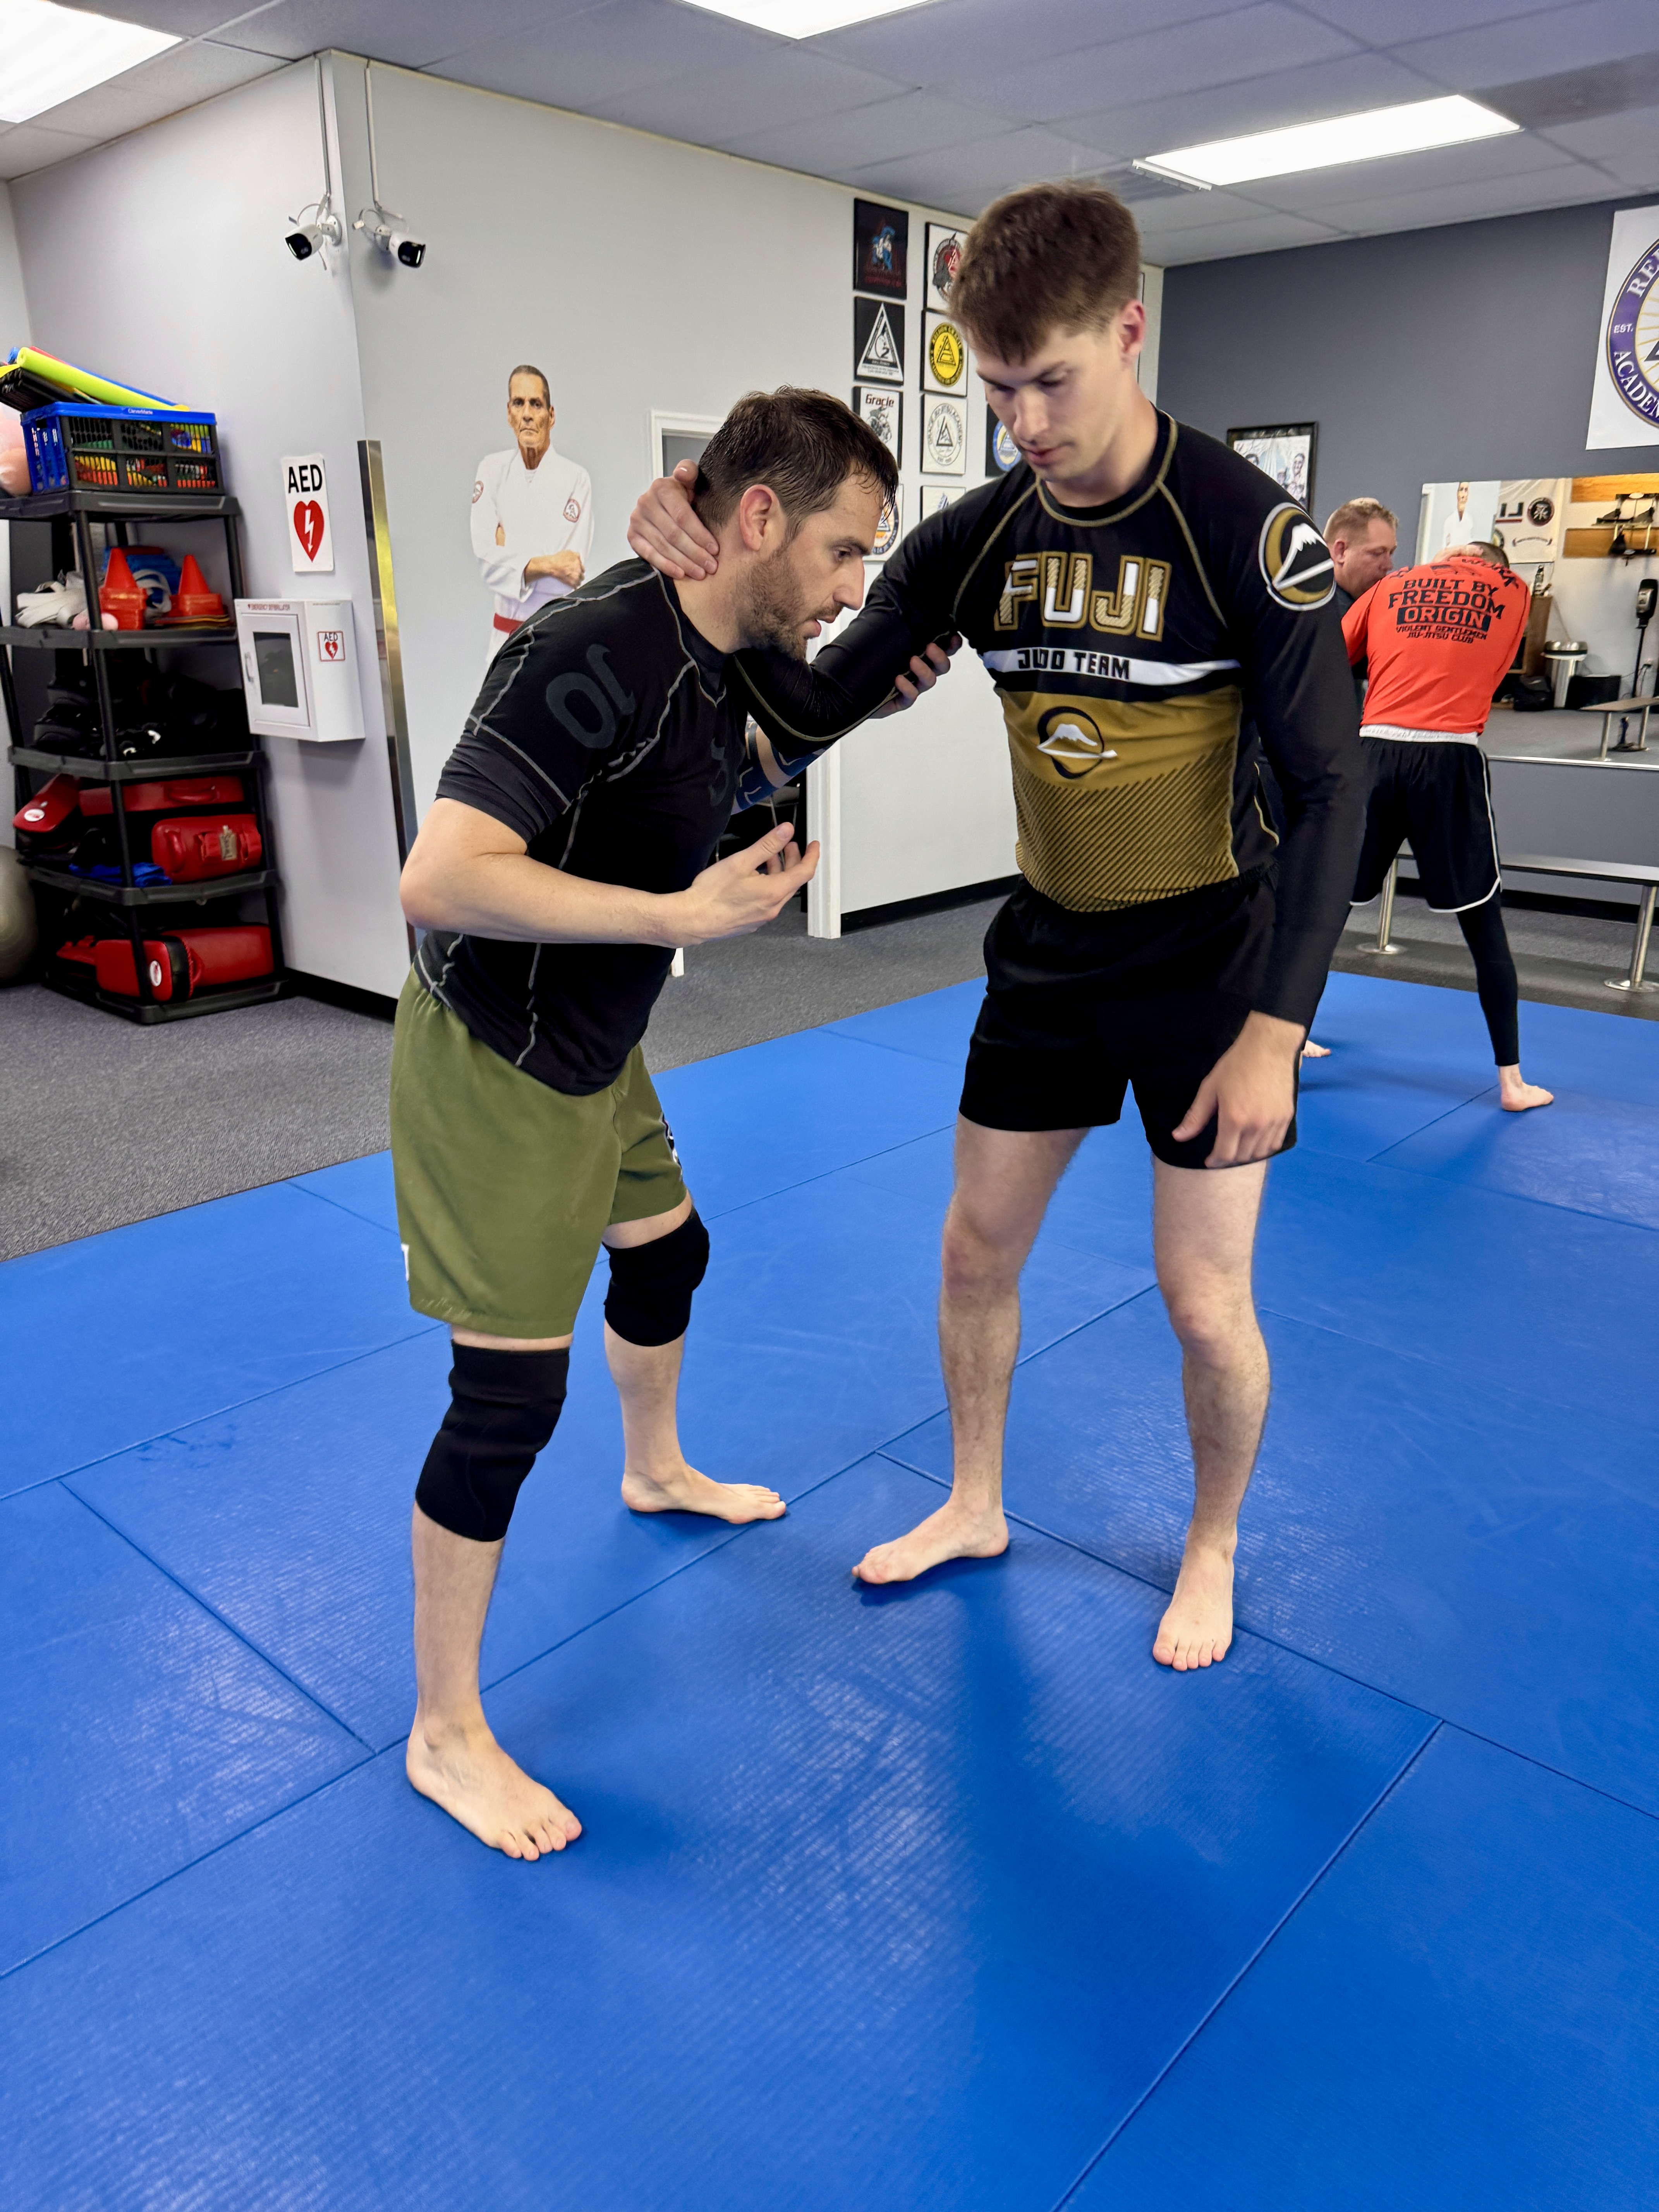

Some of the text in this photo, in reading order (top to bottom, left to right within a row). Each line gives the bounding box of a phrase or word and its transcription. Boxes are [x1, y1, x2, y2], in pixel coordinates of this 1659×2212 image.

[1614, 323, 1633, 333] EST.
[289, 464, 322, 494] AED
[994, 551, 1172, 642] FUJI
[1402, 579, 1499, 597] BUILT BY
[1388, 590, 1506, 620] FREEDOM
[1404, 606, 1485, 629] ORIGIN
[324, 632, 338, 642] AED
[1396, 625, 1487, 640] VIOLENT GENTLEMEN
[1451, 634, 1474, 644] CLUB
[1073, 652, 1130, 680] TEAM
